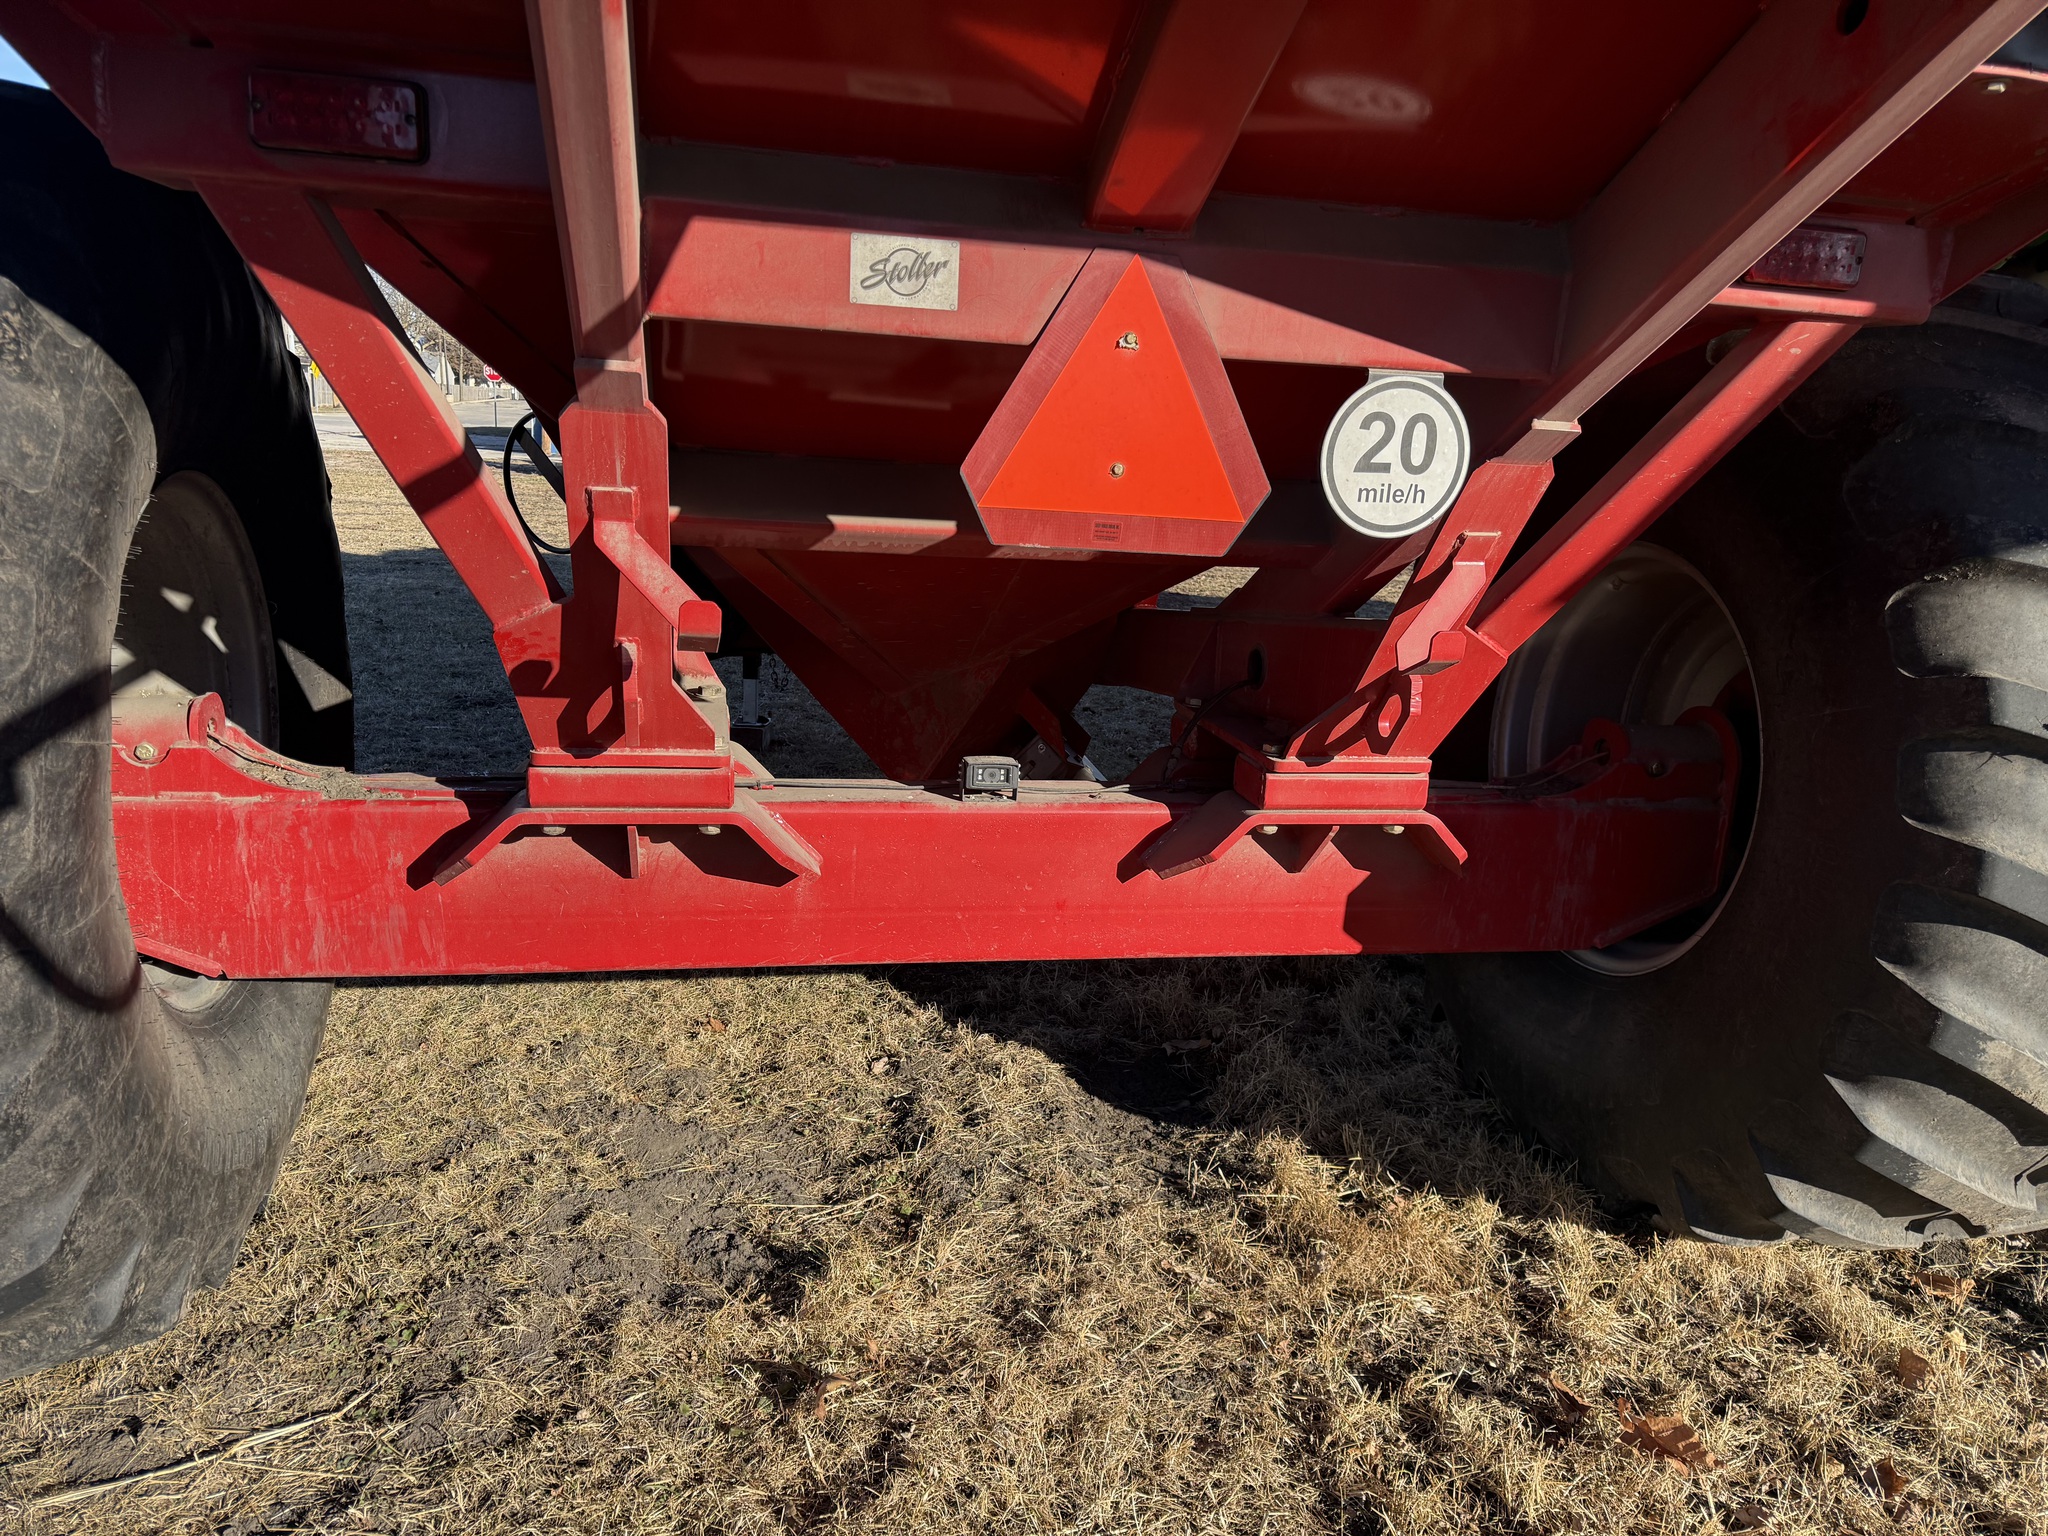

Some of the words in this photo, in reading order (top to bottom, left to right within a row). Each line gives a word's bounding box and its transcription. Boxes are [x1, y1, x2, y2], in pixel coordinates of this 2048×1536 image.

[860, 251, 950, 290] Stoller
[1353, 411, 1438, 476] 20
[1357, 483, 1426, 504] mile/h
